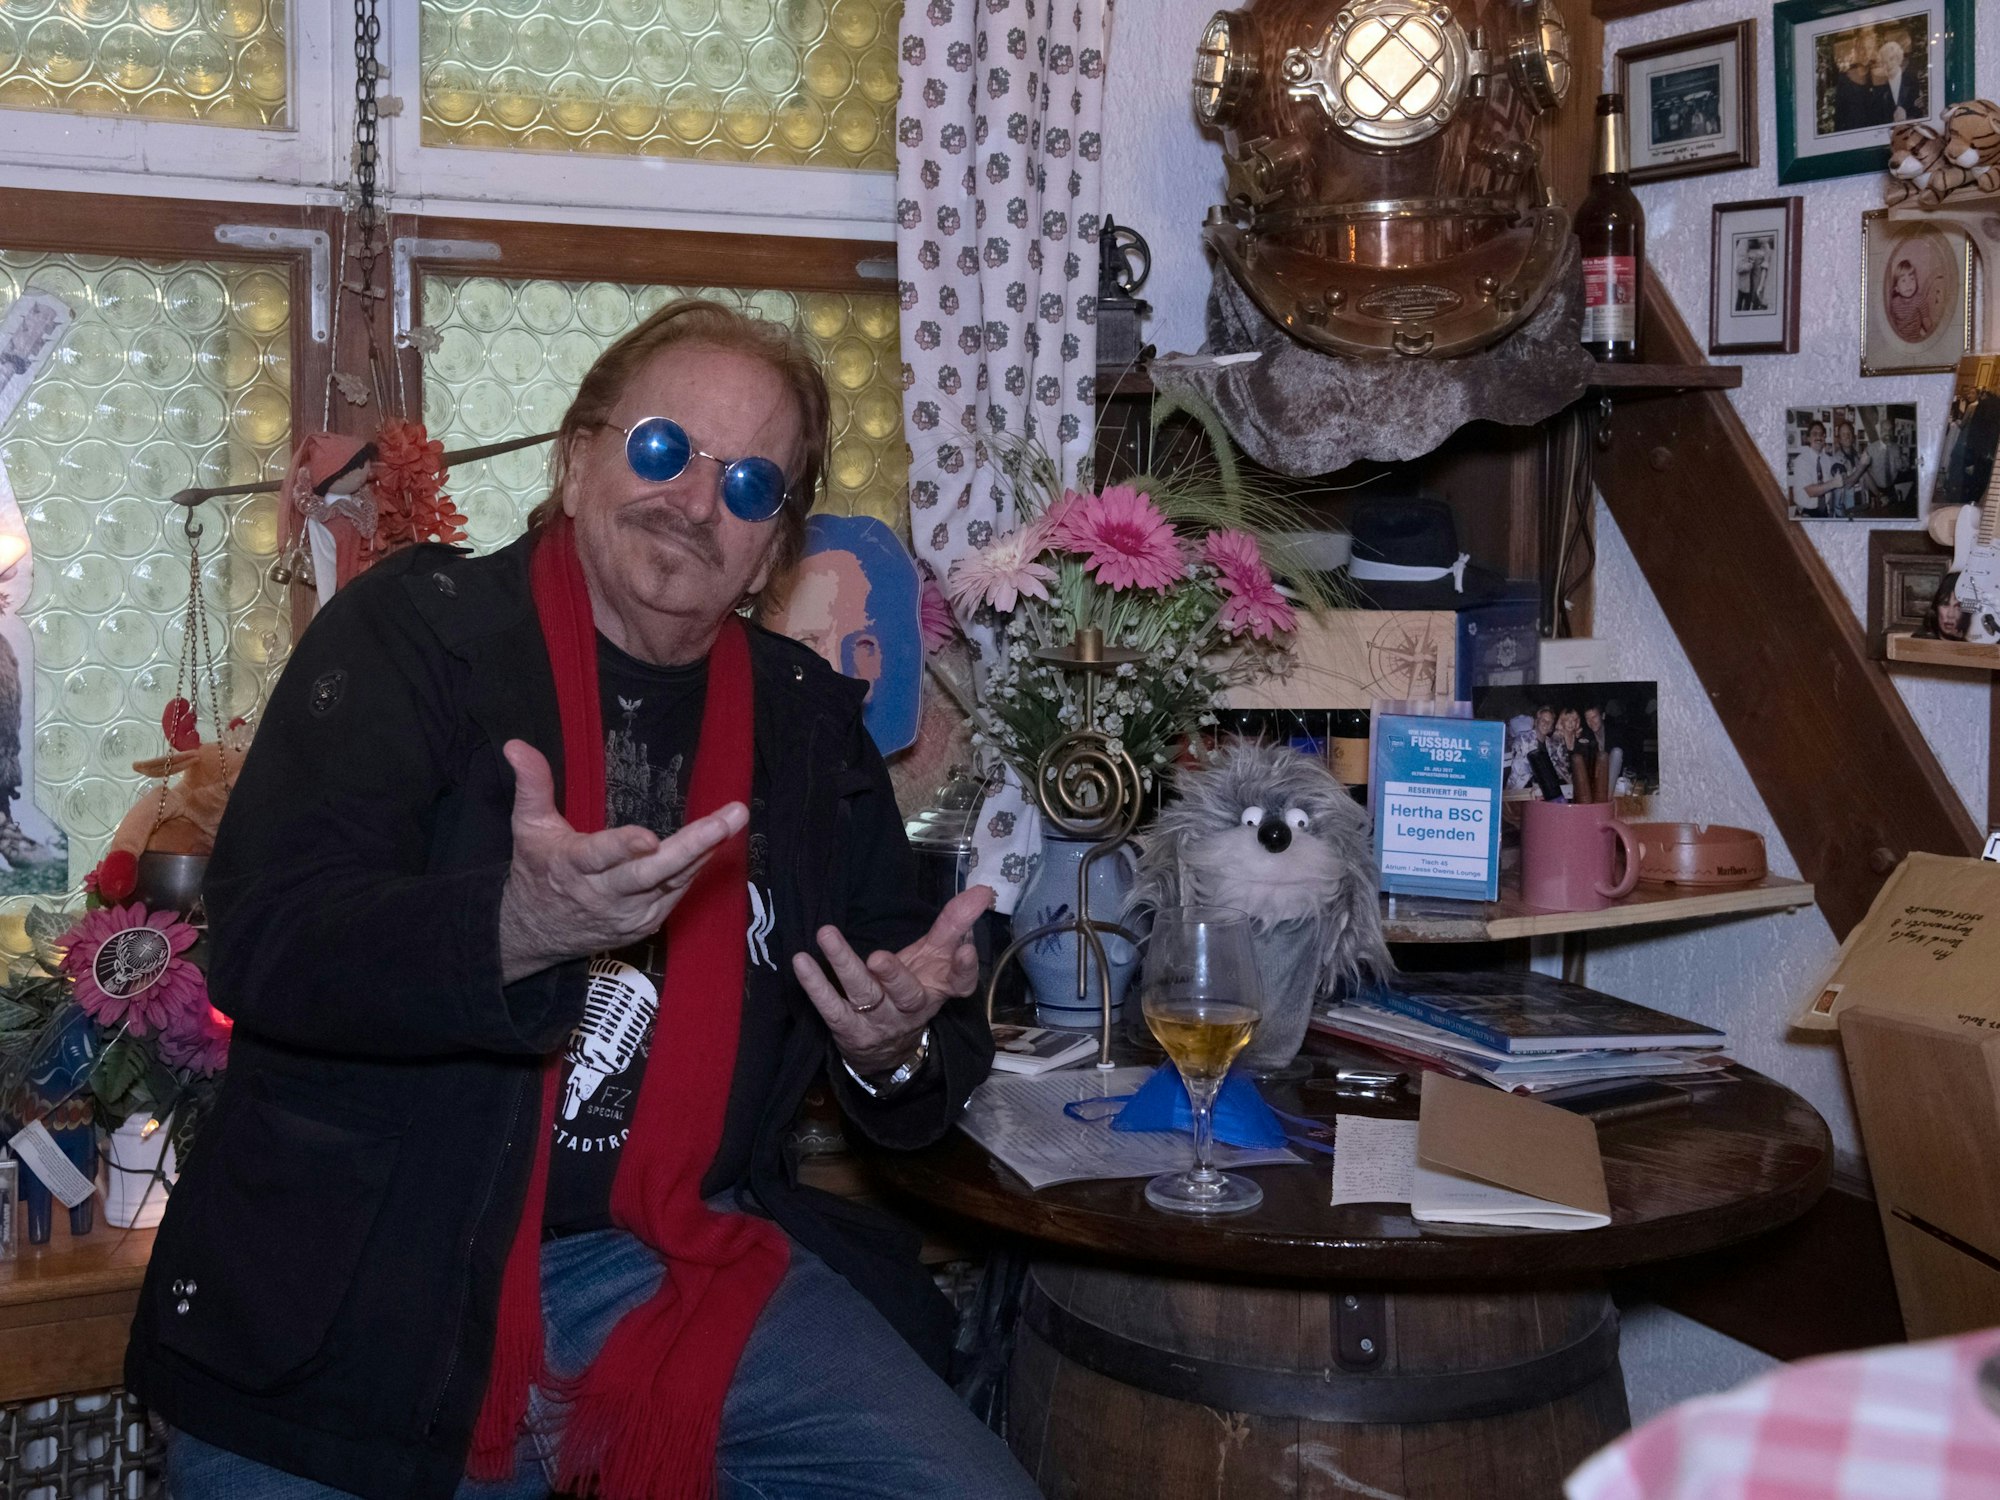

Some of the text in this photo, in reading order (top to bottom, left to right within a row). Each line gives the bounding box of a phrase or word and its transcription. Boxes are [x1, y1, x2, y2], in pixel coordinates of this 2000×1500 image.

[1410, 736, 1472, 751] FUSSBALL
[1430, 749, 1467, 763] 1892.
[1408, 786, 1468, 797] RESERVIERT FÜR
[1391, 803, 1483, 822] Hertha BSC
[1397, 823, 1475, 841] Legenden
[1421, 858, 1439, 866] Tisch
[1385, 863, 1407, 871] Atrium
[1456, 869, 1481, 878] Lounge
[1932, 949, 1954, 961] An
[1957, 1013, 1987, 1027] Berlin
[601, 1085, 632, 1109] FZ
[587, 1105, 624, 1120] SPECIAL
